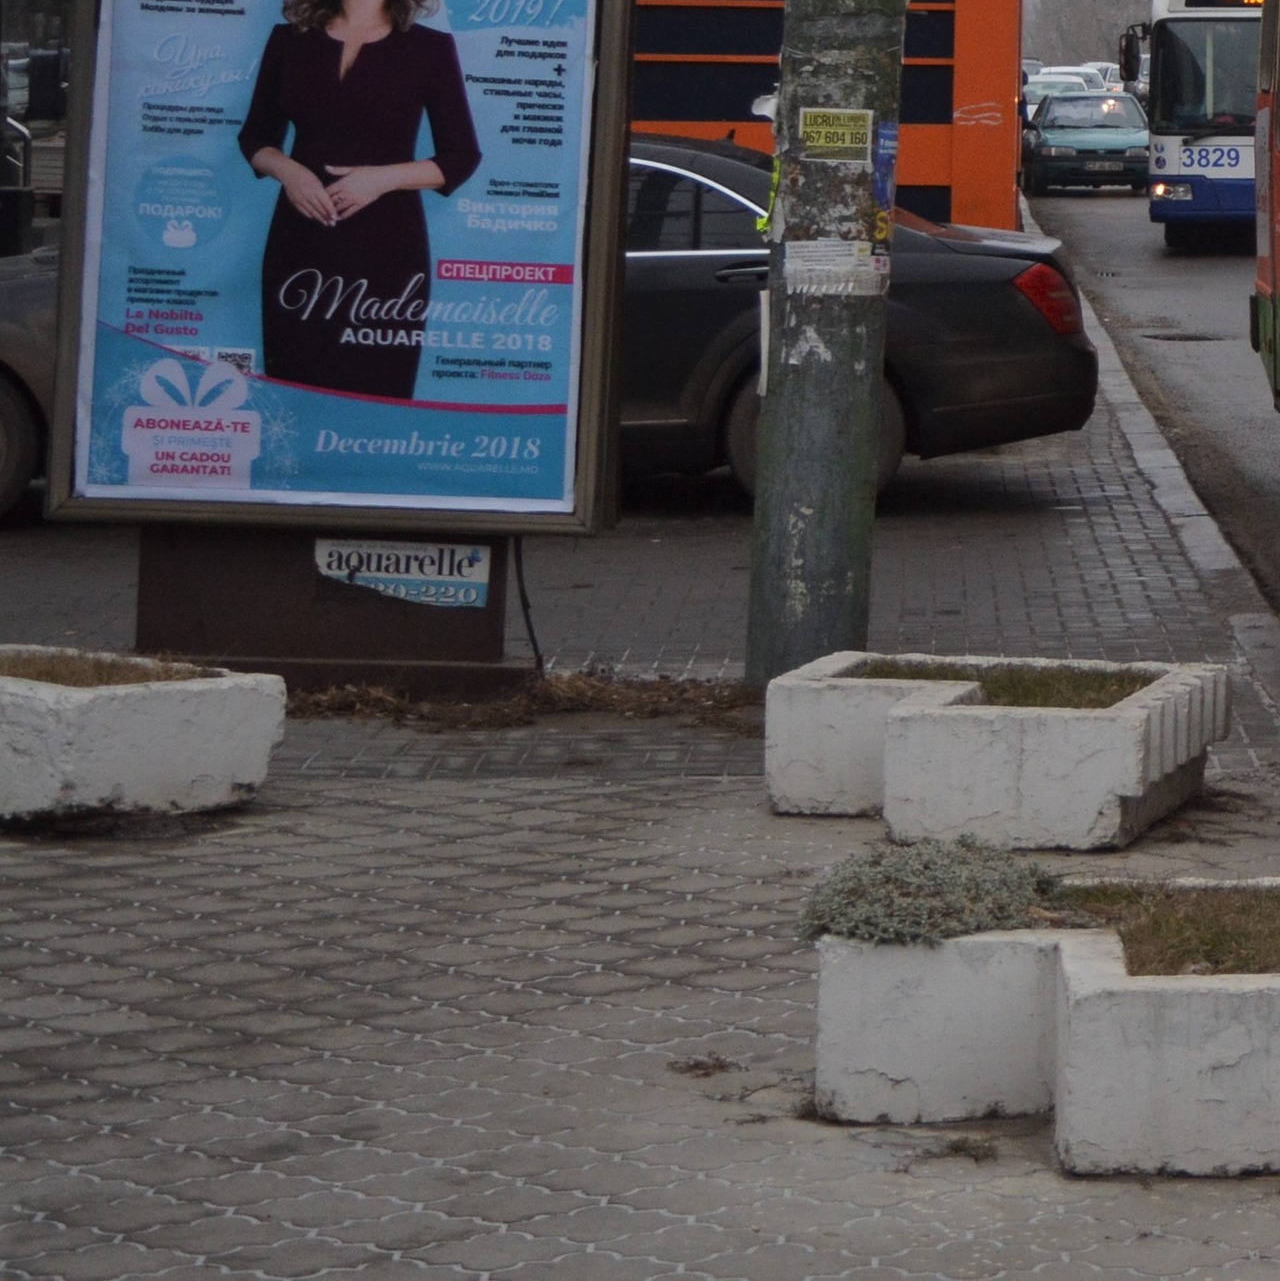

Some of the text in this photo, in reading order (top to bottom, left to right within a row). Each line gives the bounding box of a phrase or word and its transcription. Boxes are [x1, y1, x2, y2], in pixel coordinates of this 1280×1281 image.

[804, 114, 835, 127] LUCRU
[802, 130, 821, 144] 067
[825, 131, 846, 144] 604
[850, 131, 868, 145] 160
[1181, 147, 1240, 168] 3829
[139, 203, 223, 219] ПОДАРОК!
[457, 198, 559, 217] Виктория
[467, 214, 558, 233] Бадичко
[440, 262, 557, 281] СПЕЦПРОЕКТ
[278, 267, 559, 327] Mademoiselle
[125, 307, 144, 318] La
[125, 322, 199, 336] Del Gusto
[340, 327, 553, 351] AQUARELLE 2018
[436, 355, 552, 371] Генеральный партнер
[432, 368, 551, 382] проекта: Fitness Doza
[133, 418, 251, 433] ABONEAZĂ-TE
[315, 429, 542, 460] Decembrie 2018
[155, 451, 231, 463] UN CADOU
[150, 463, 231, 476] GARANTAT!
[326, 547, 475, 578] aquarelle
